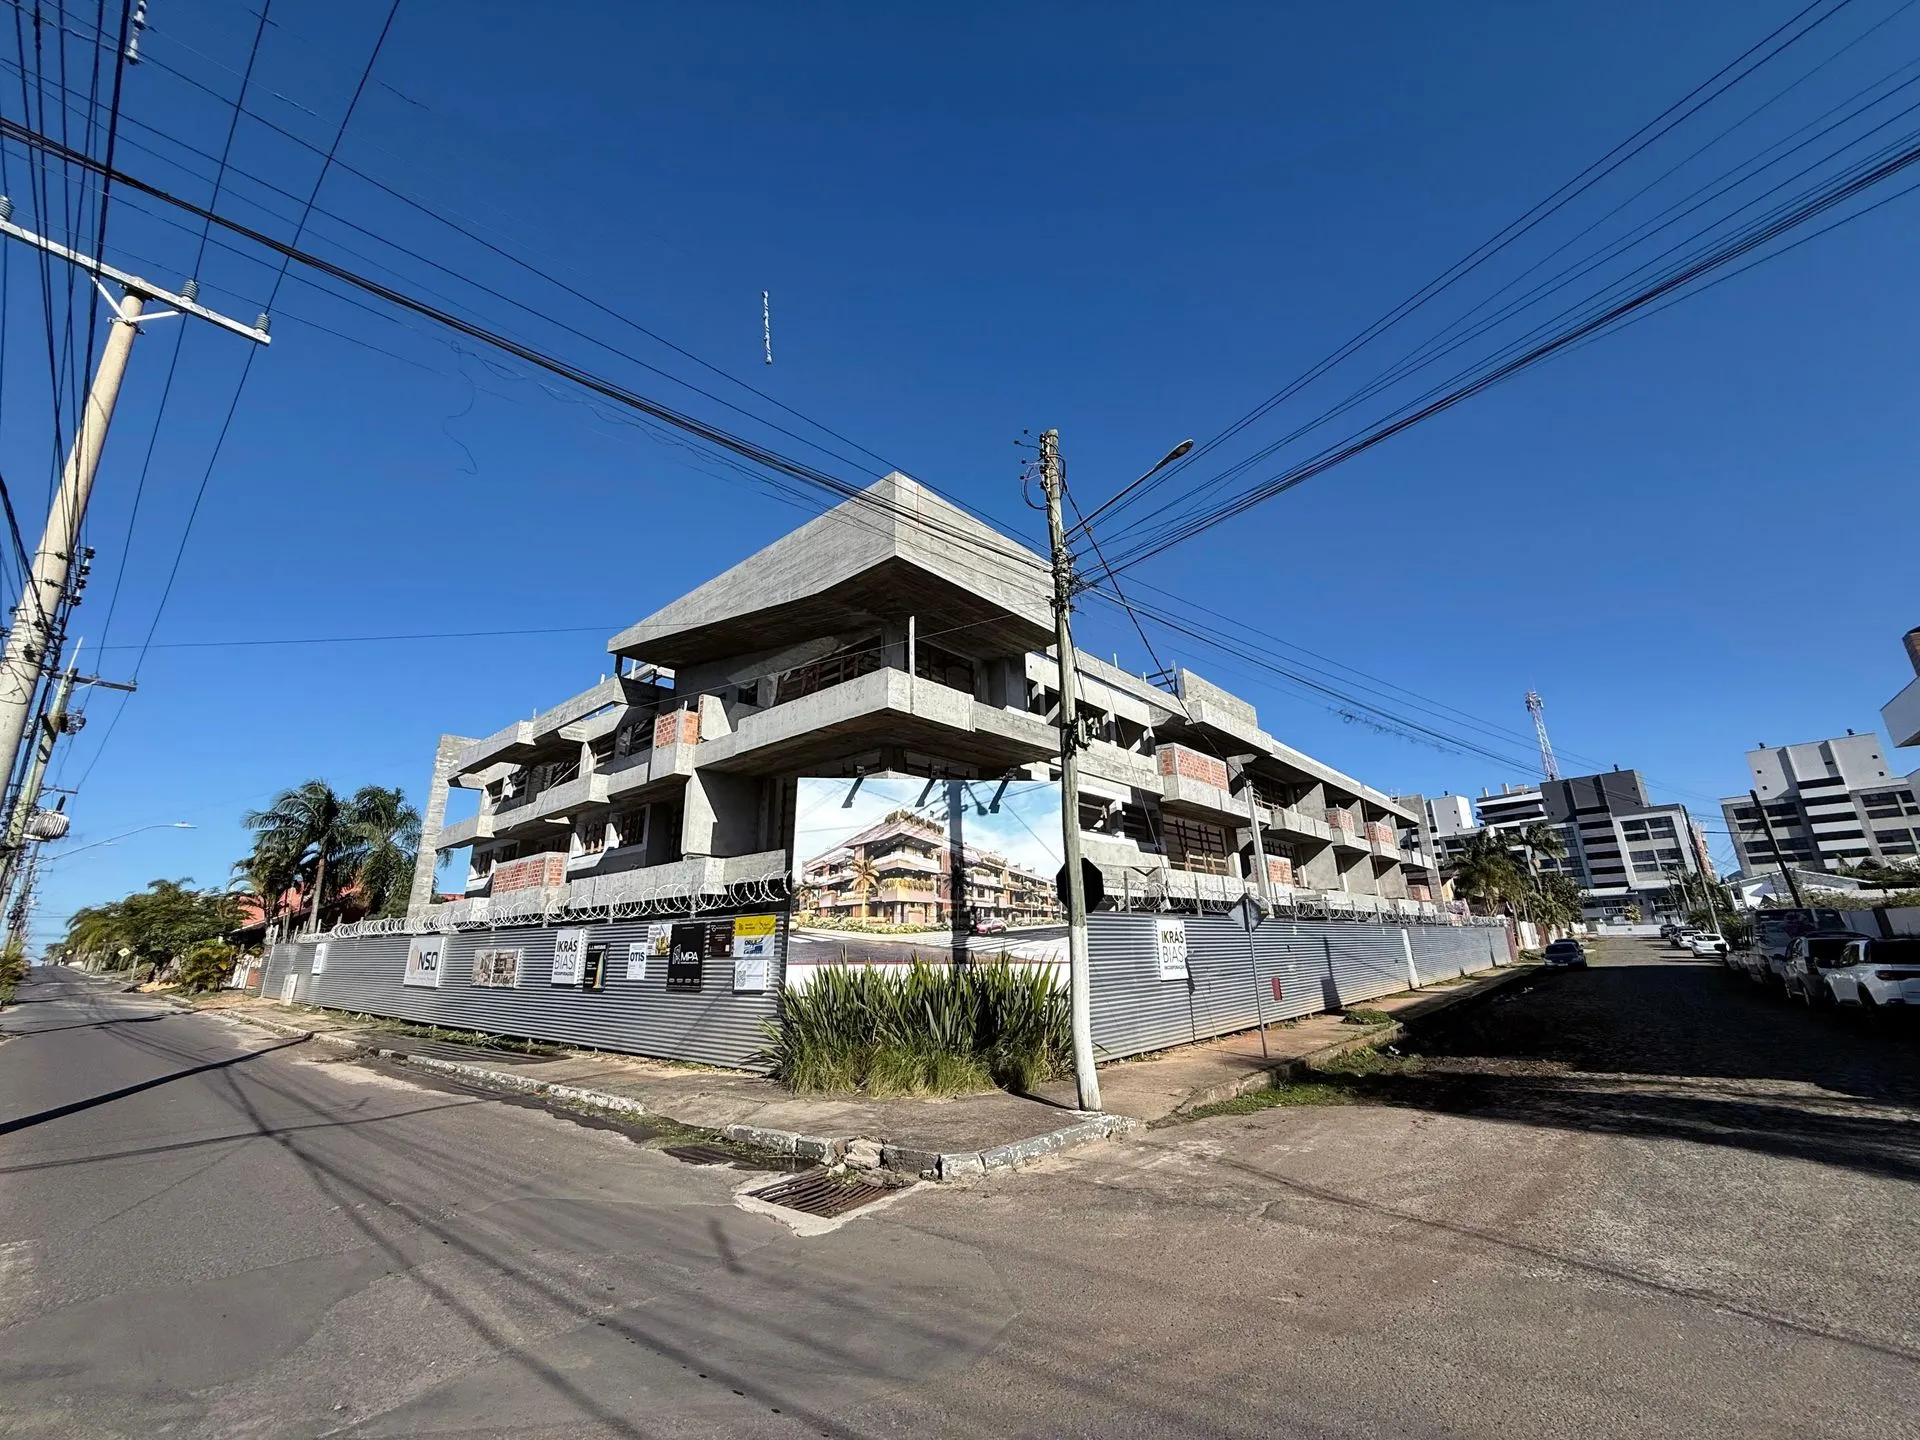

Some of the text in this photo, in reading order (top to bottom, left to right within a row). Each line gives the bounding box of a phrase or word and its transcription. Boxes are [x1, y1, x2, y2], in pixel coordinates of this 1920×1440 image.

[1161, 927, 1184, 943] IKRÁS
[556, 937, 578, 952] IKRÁS
[630, 952, 645, 962] OTIS
[680, 951, 699, 961] MPA
